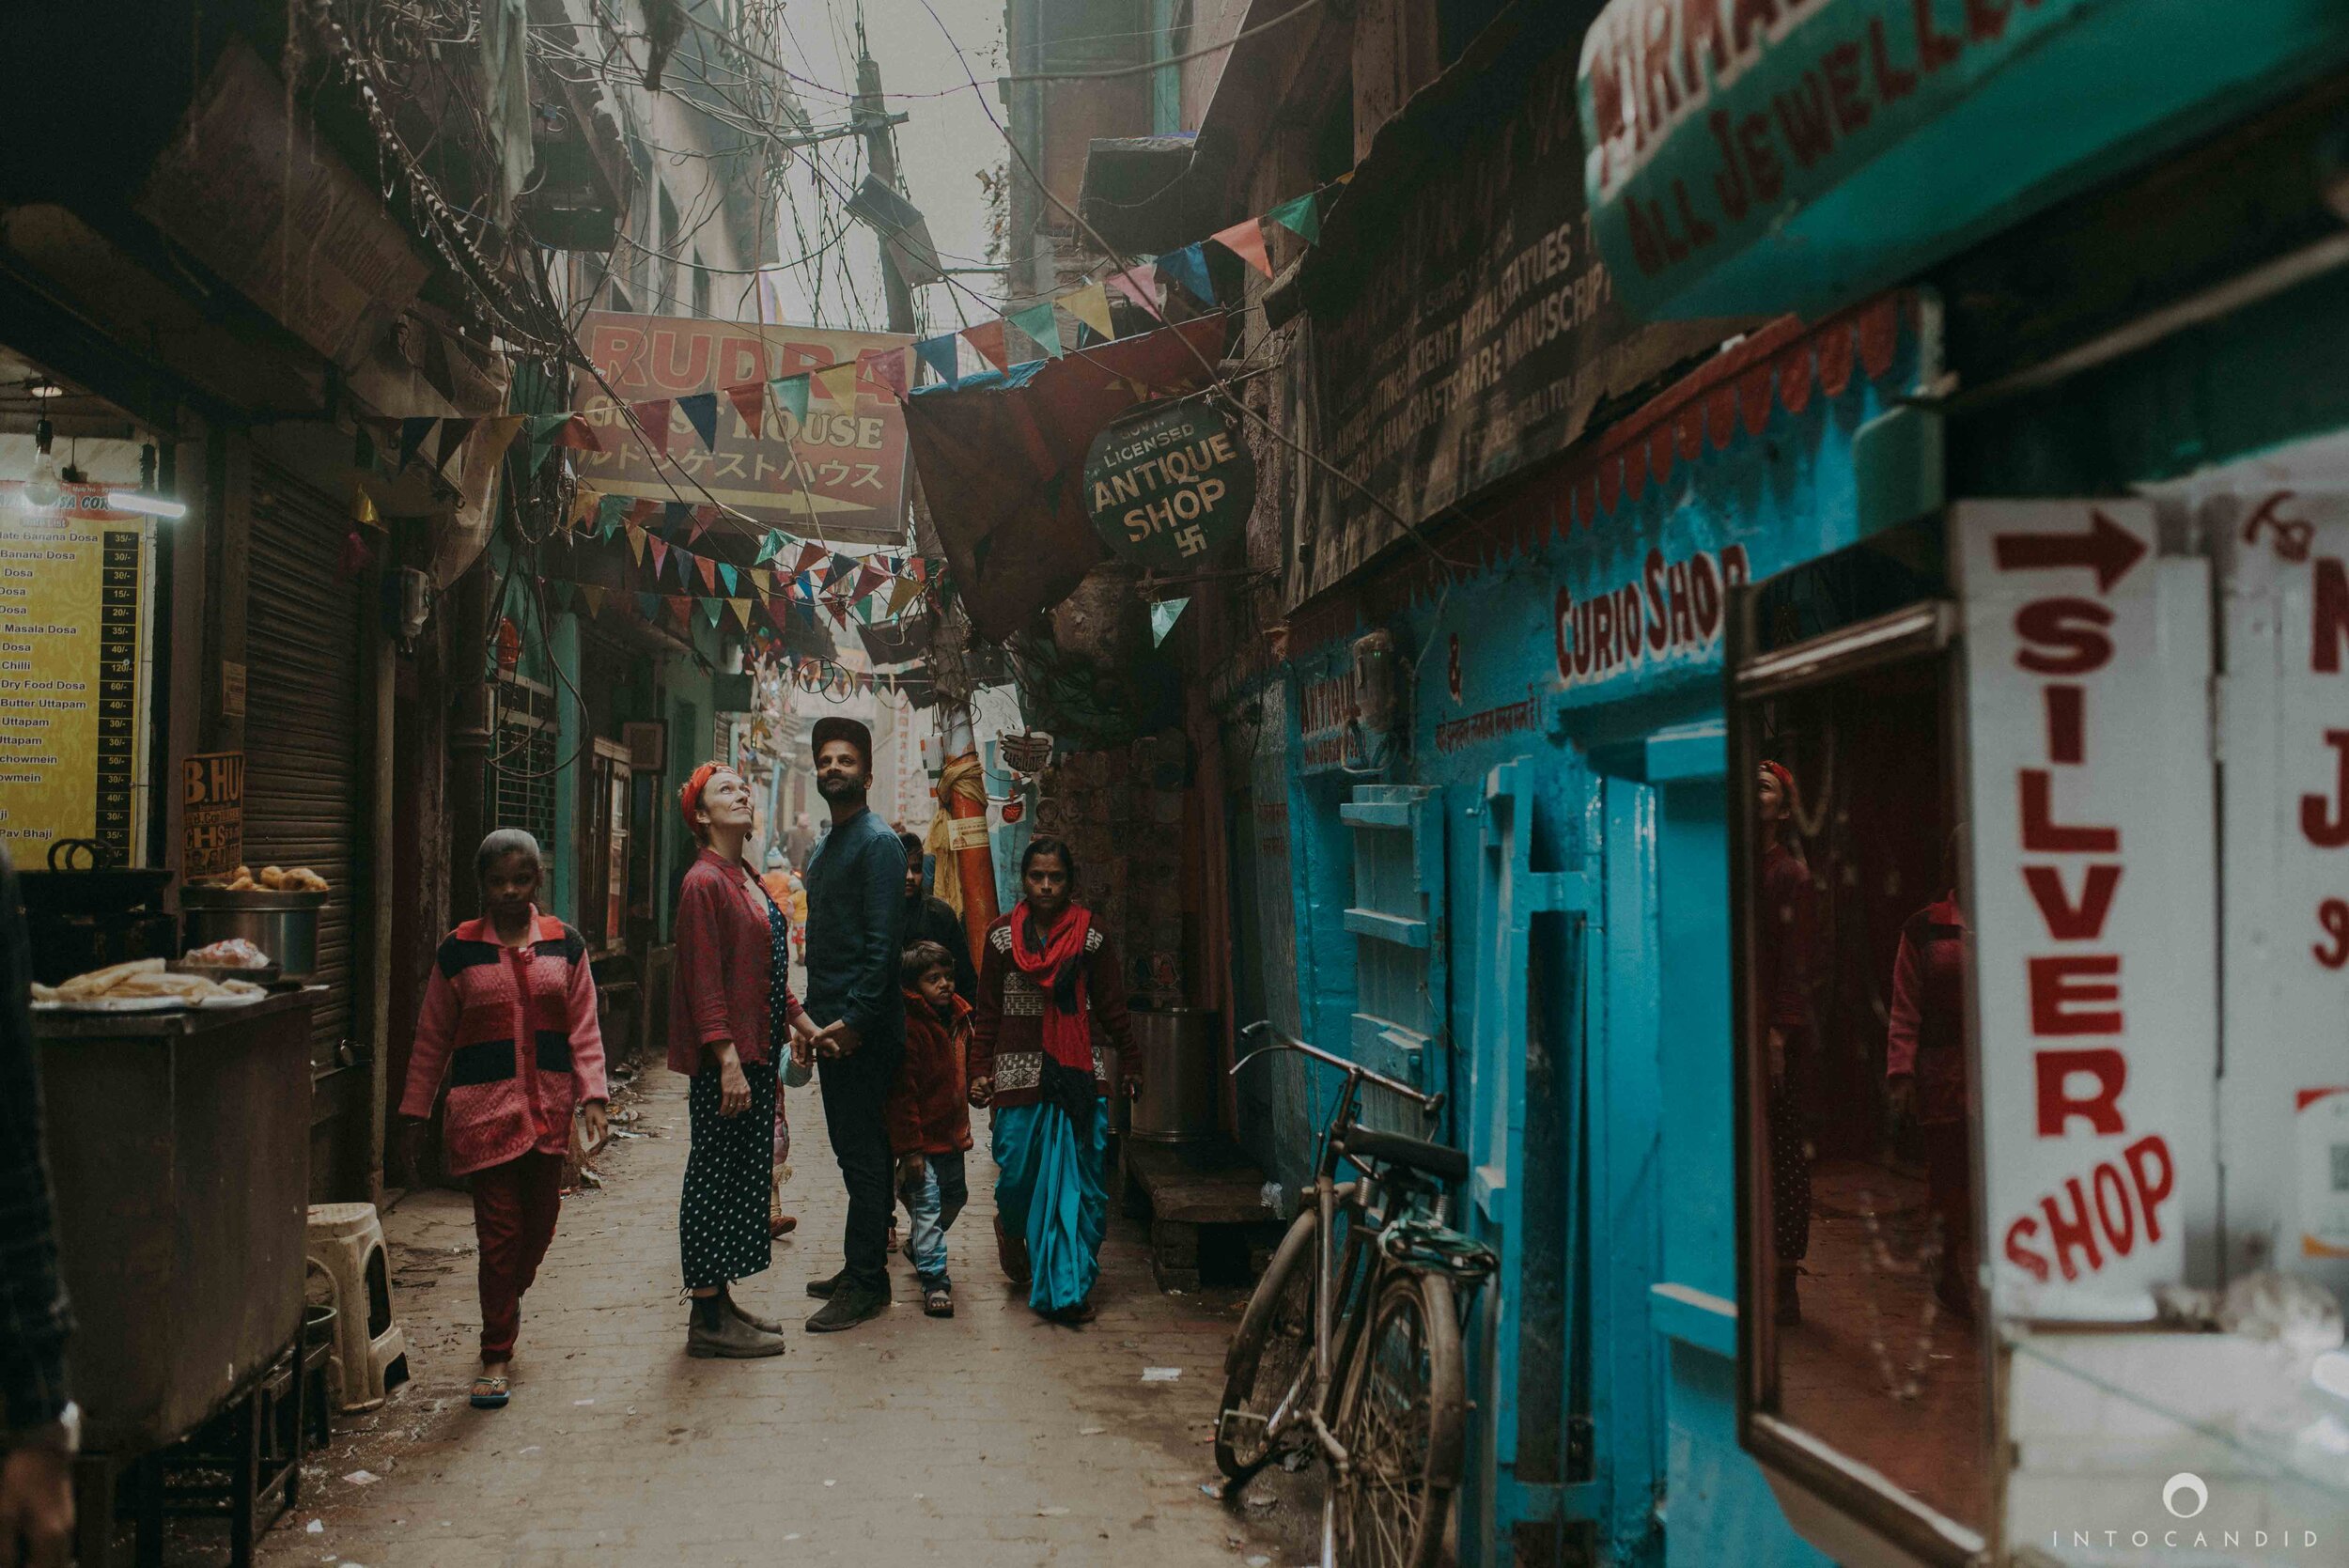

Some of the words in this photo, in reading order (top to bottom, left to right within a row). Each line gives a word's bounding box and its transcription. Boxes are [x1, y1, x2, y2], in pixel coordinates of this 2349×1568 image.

[1593, 0, 1806, 192] NIRMA
[1626, 179, 1715, 276] ALL
[1707, 0, 2041, 222] JEWELLE
[1461, 285, 1501, 351] METAL
[1501, 222, 1570, 316] STATUES
[589, 325, 902, 407] RUDRA
[1461, 338, 1501, 400] RARE
[583, 394, 726, 438] GUS
[1103, 423, 1195, 468] LICENSED
[1094, 431, 1238, 513] ANTIQUE
[1123, 478, 1226, 542] SHOP
[23, 533, 67, 542] Banana
[69, 534, 99, 542] Dosa
[115, 534, 132, 542] 35/-
[0, 551, 43, 559] Banana
[46, 551, 76, 560] Dosa
[4, 568, 34, 578] Dosa
[114, 590, 131, 598] 15/-
[0, 605, 27, 614] Dosa
[112, 608, 130, 616] 20/-
[5, 625, 44, 634] Masala
[48, 626, 77, 634] Dosa
[112, 627, 129, 635] 35/-
[2, 643, 31, 652] Dosa
[111, 645, 128, 654] 40/-
[1301, 669, 1361, 736] ANTIQU
[1554, 582, 1641, 680] CURIO
[2, 660, 31, 670] Chilli
[111, 663, 132, 673] 120/-
[1, 680, 21, 691] Dry
[24, 680, 54, 690] Food
[56, 681, 86, 691] Dosa
[110, 682, 127, 691] 60/-
[0, 699, 36, 707] Butter
[39, 699, 86, 709] Uttapam
[109, 701, 127, 709] 40/-
[1, 718, 50, 727] Uttapam
[109, 720, 126, 728] 30/-
[108, 738, 126, 747] 30/-
[0, 755, 57, 765] chowmein
[108, 756, 125, 765] 50/-
[107, 775, 124, 784] 30/-
[106, 793, 124, 802] 40/-
[106, 812, 123, 820] 30/-
[0, 830, 19, 838] Pav
[23, 830, 53, 839] Bhaji
[106, 831, 122, 839] 35/-
[2014, 596, 2127, 1139] SILVER
[2004, 1132, 2178, 1283] SHOP
